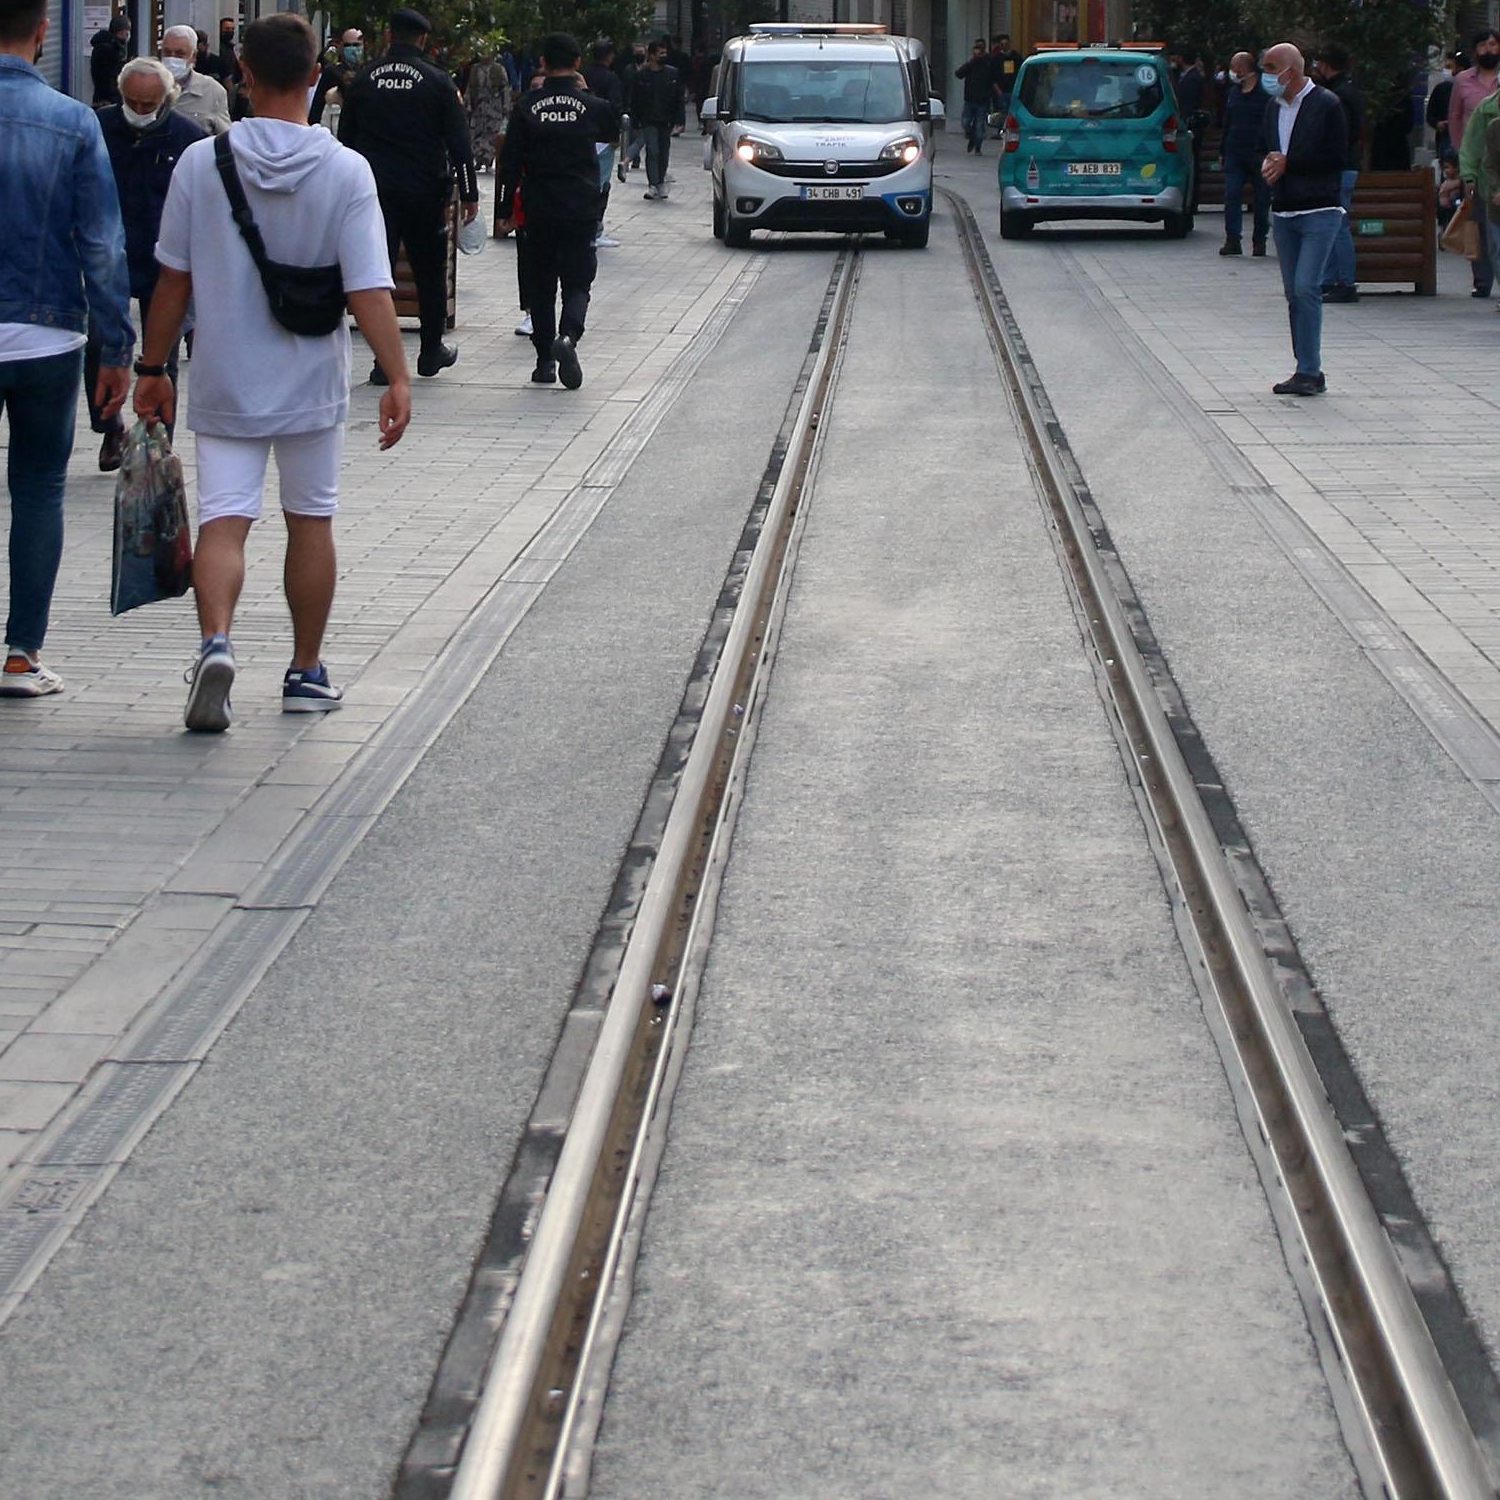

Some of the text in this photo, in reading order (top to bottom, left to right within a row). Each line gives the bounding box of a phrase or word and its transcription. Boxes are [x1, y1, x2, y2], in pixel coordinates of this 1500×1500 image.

[394, 62, 424, 83] KUVVET
[1140, 71, 1153, 80] 16
[555, 95, 588, 116] KUVVET
[1067, 163, 1119, 173] 34 AEB 833
[807, 188, 861, 198] 34 CHB 491
